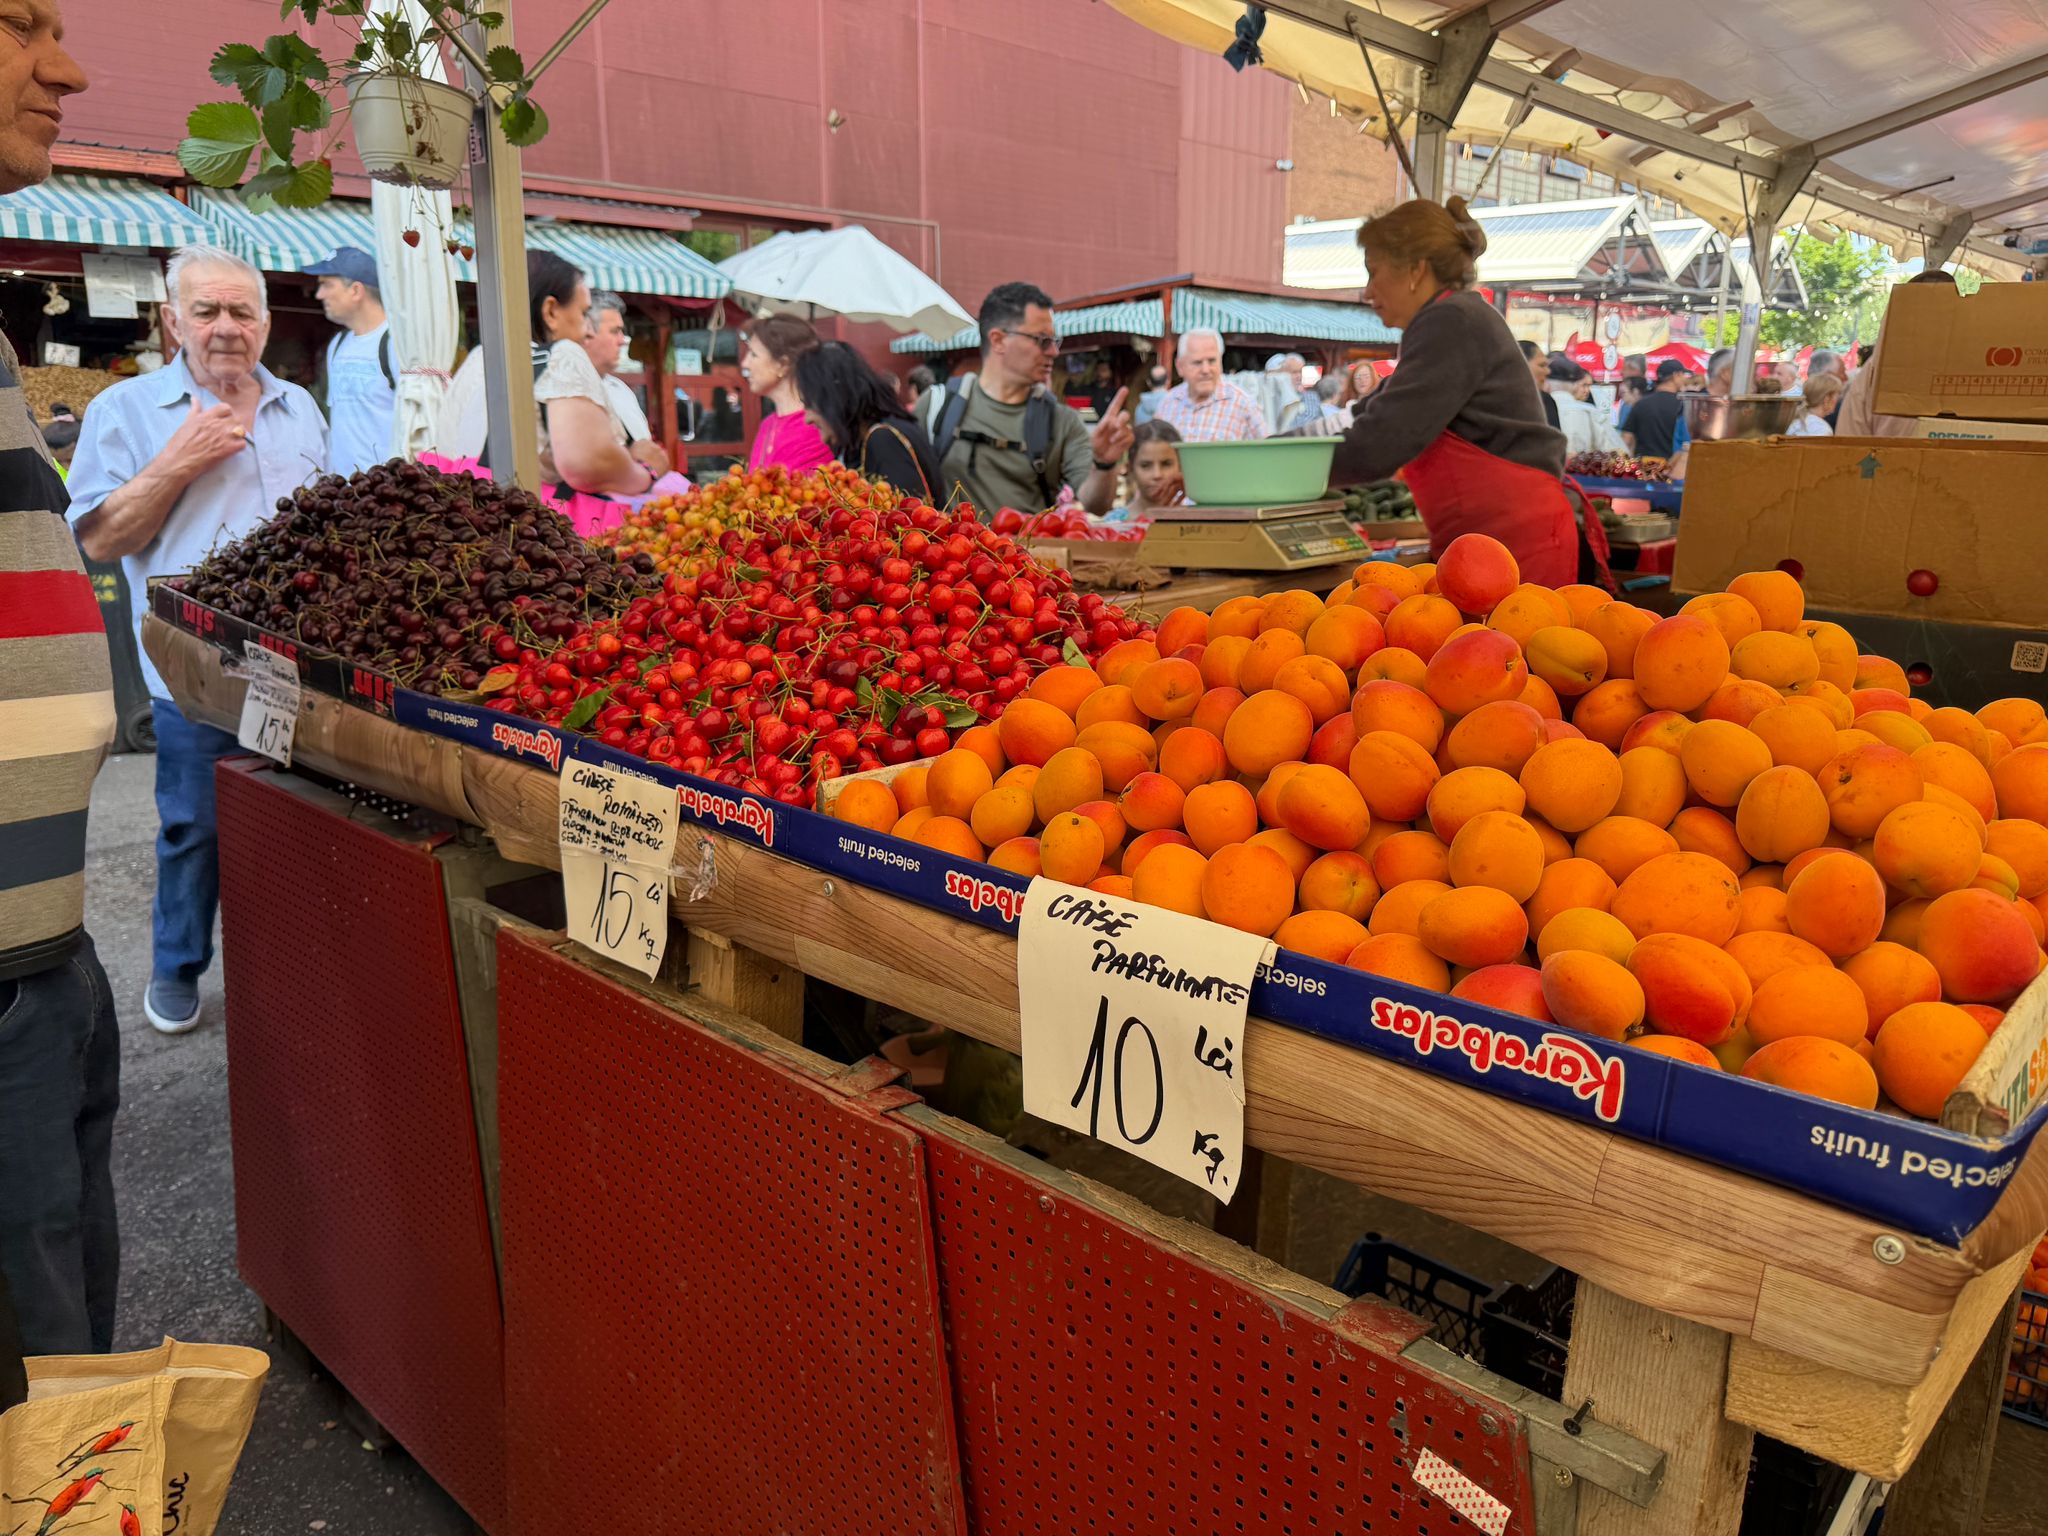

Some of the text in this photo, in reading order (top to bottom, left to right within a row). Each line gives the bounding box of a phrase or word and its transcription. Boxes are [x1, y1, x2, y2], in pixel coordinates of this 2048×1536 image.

[256, 711, 280, 754] 15
[444, 711, 479, 729] selected
[492, 722, 562, 771] Karabelas
[677, 784, 775, 848] Karabelas
[838, 836, 921, 873] selected fruits
[590, 862, 639, 949] 15
[1254, 962, 1327, 997] selecte
[1070, 995, 1165, 1146] 10
[1370, 996, 1625, 1123] Karabelas
[1810, 1124, 2018, 1189] selected fruits
